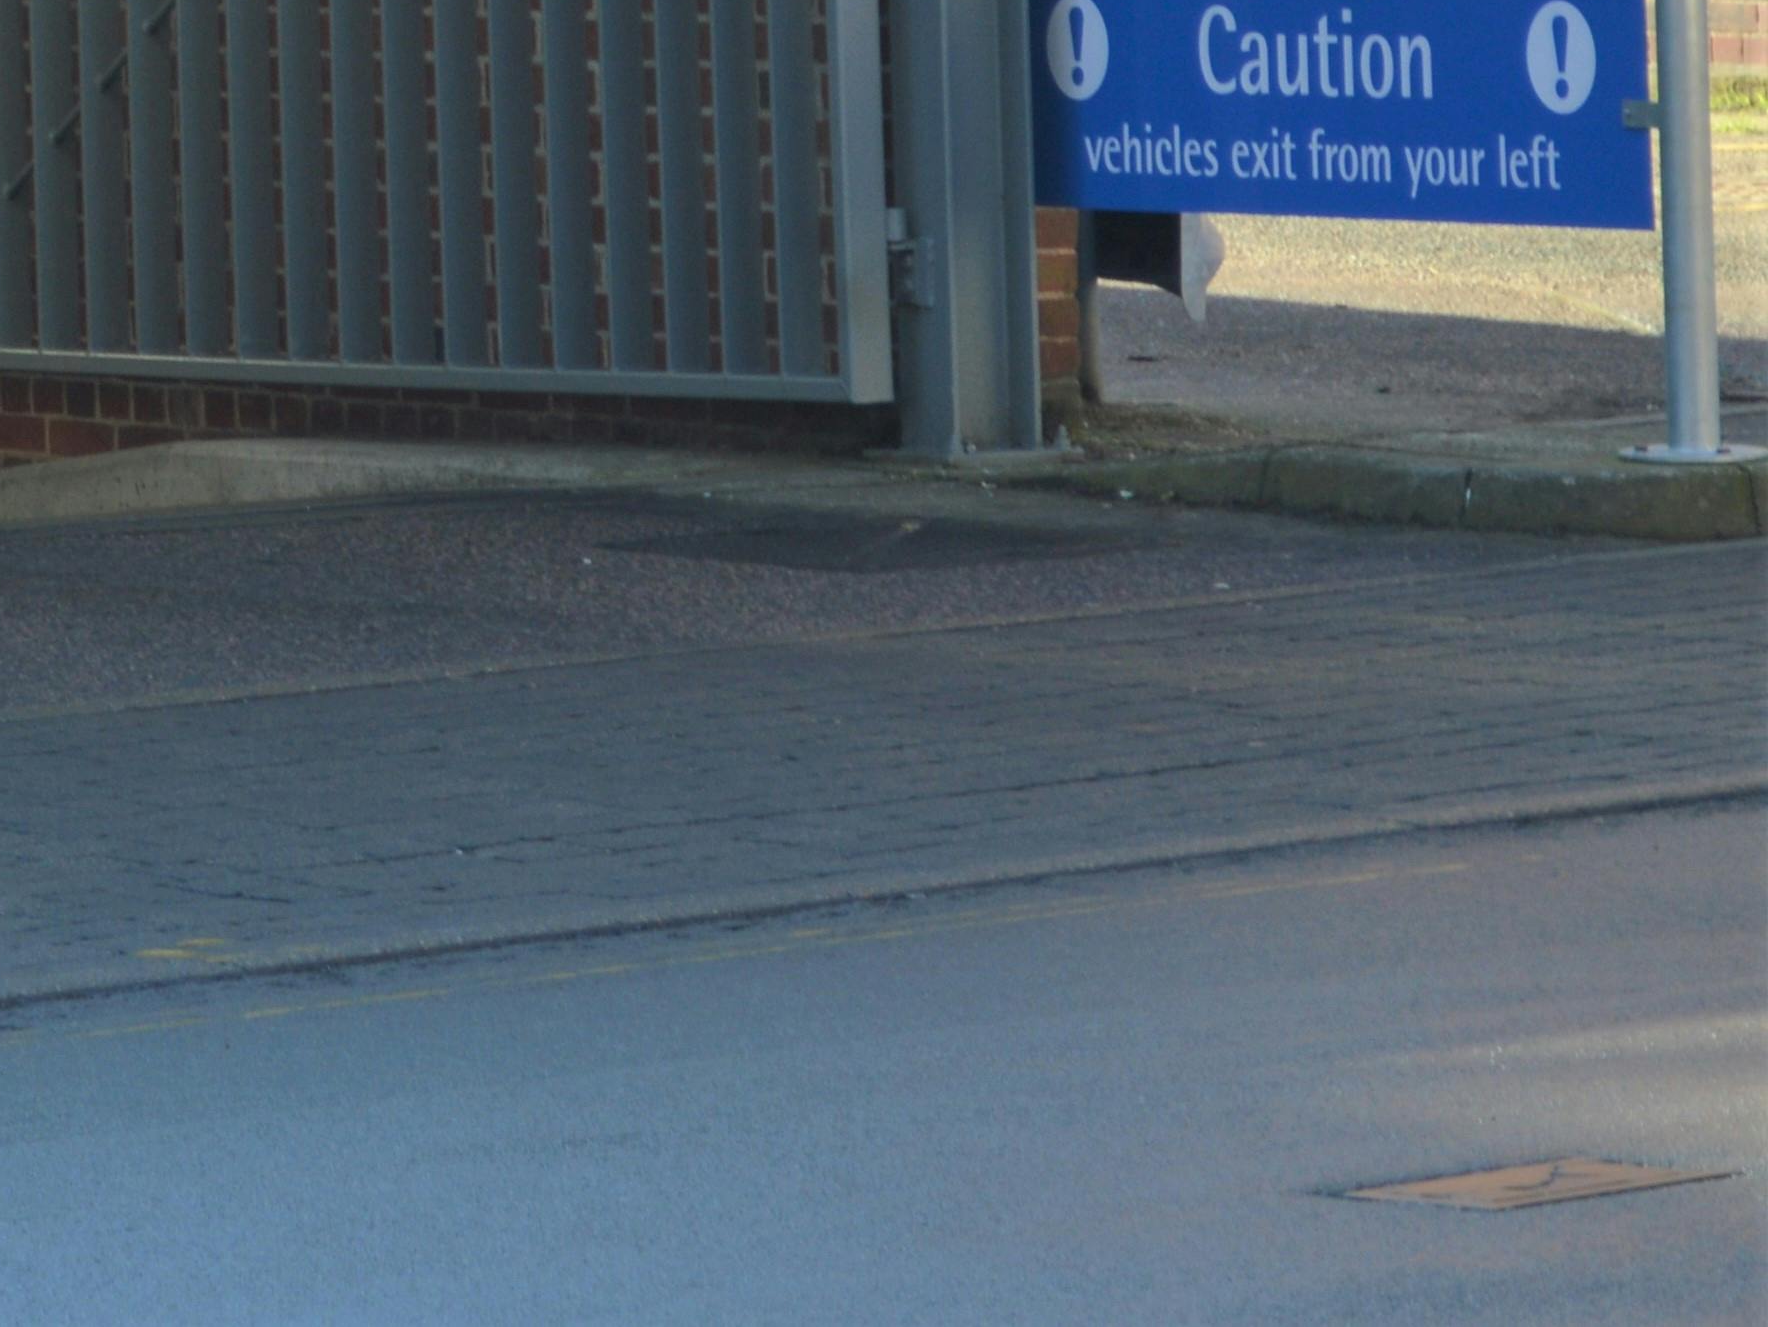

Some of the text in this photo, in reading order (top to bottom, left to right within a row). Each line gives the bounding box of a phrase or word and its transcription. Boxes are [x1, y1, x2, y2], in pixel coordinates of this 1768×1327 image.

[1197, 3, 1434, 100] Caution
[1083, 123, 1561, 199] vehicles exit from your left
